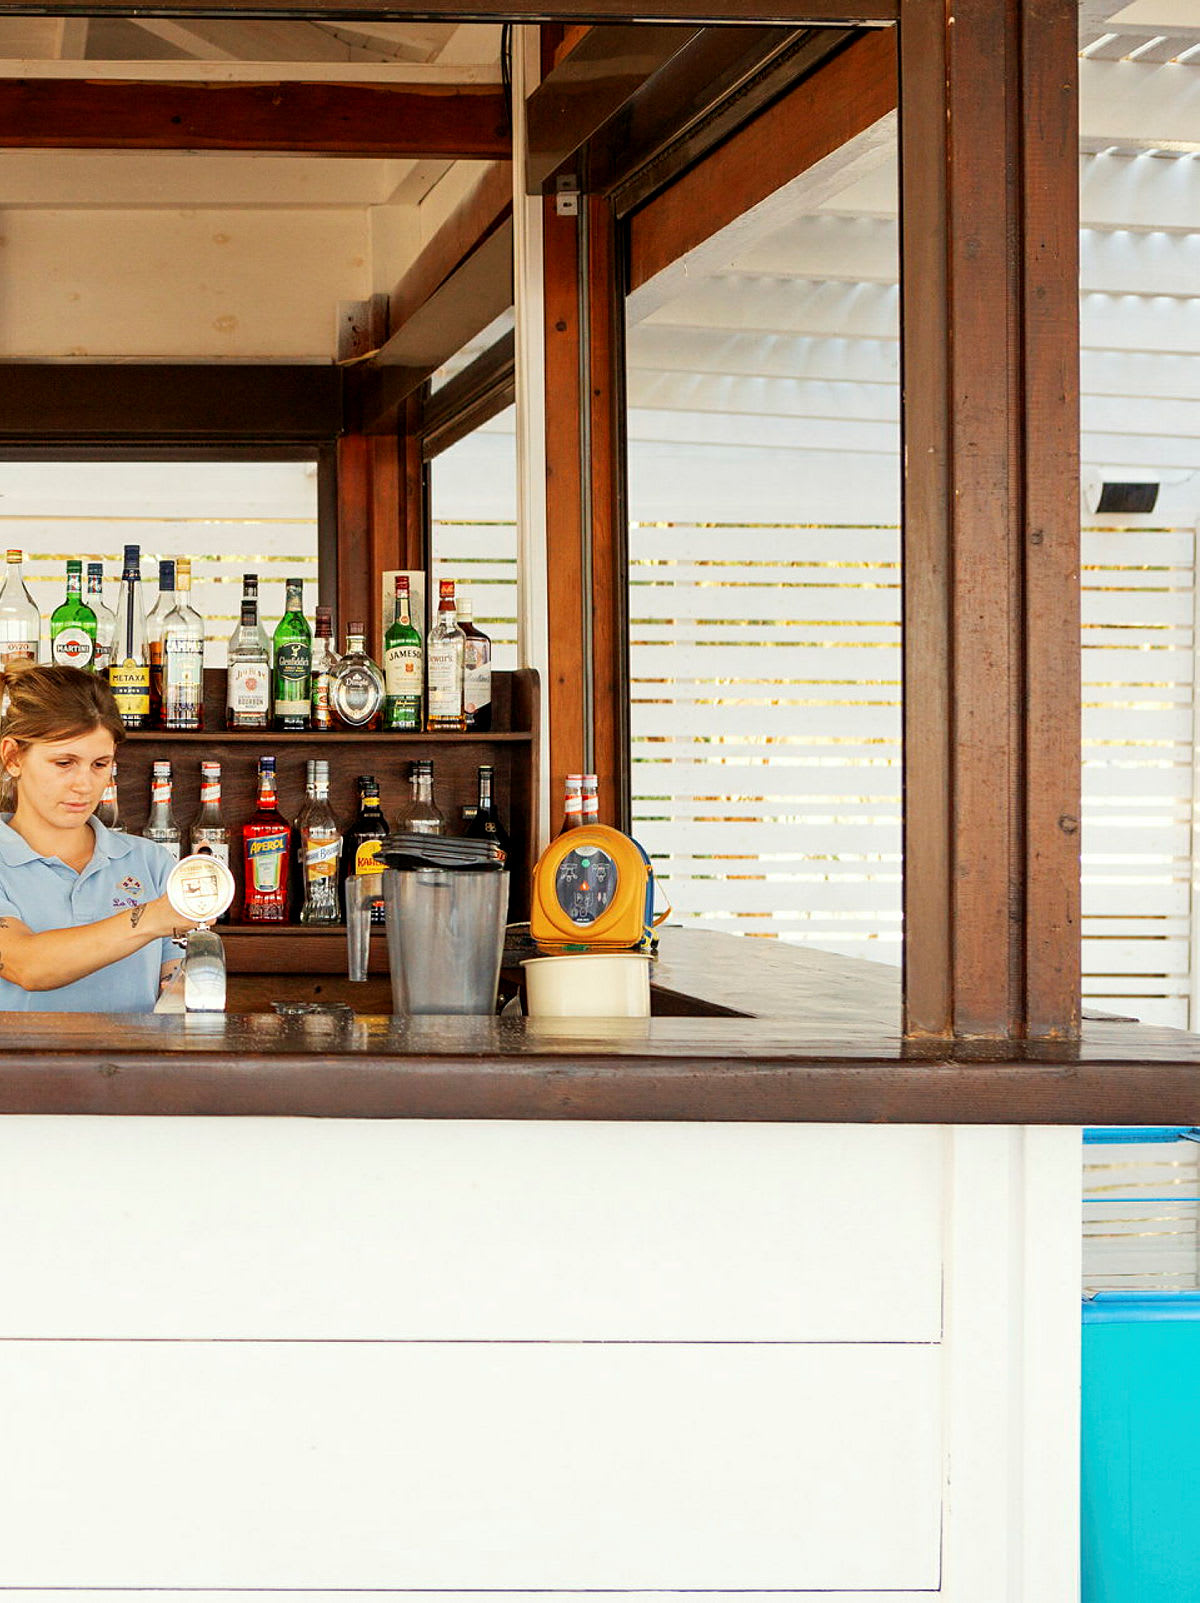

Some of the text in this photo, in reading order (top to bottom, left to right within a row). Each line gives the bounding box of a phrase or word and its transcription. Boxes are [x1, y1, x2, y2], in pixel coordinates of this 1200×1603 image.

[56, 645, 90, 653] MARTINI
[389, 649, 421, 661] JAMESO
[112, 674, 146, 682] METAXA
[250, 839, 284, 855] APEROL
